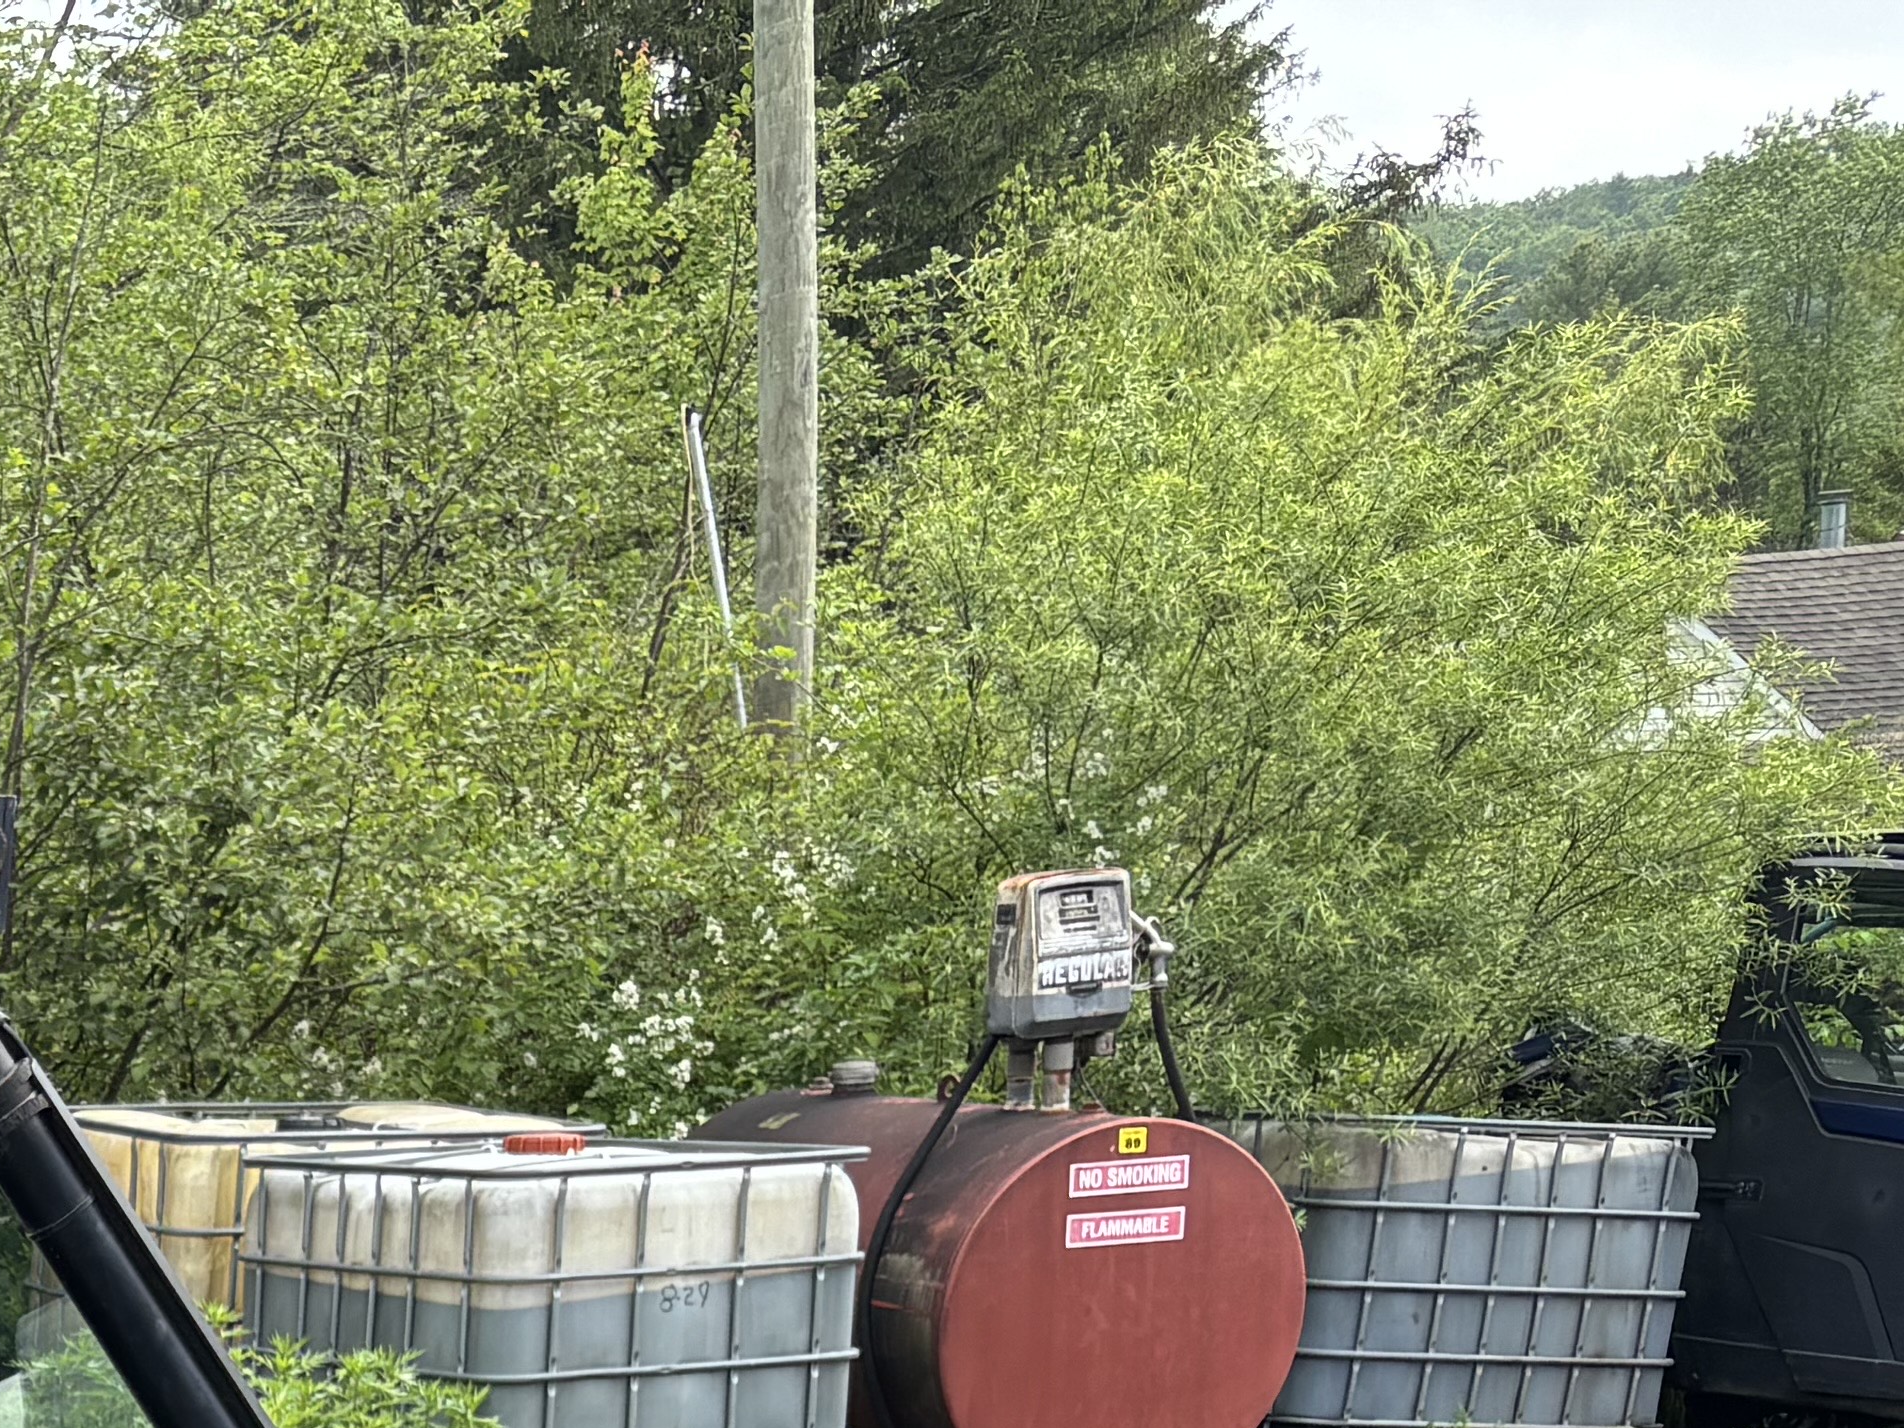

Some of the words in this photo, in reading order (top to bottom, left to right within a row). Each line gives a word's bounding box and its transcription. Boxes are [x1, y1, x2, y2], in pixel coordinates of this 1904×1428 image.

[1042, 953, 1129, 986] REGULAR
[1079, 1168, 1103, 1189] NO
[1107, 1160, 1181, 1187] SMOKING
[1081, 1215, 1170, 1239] FLAMMABLE
